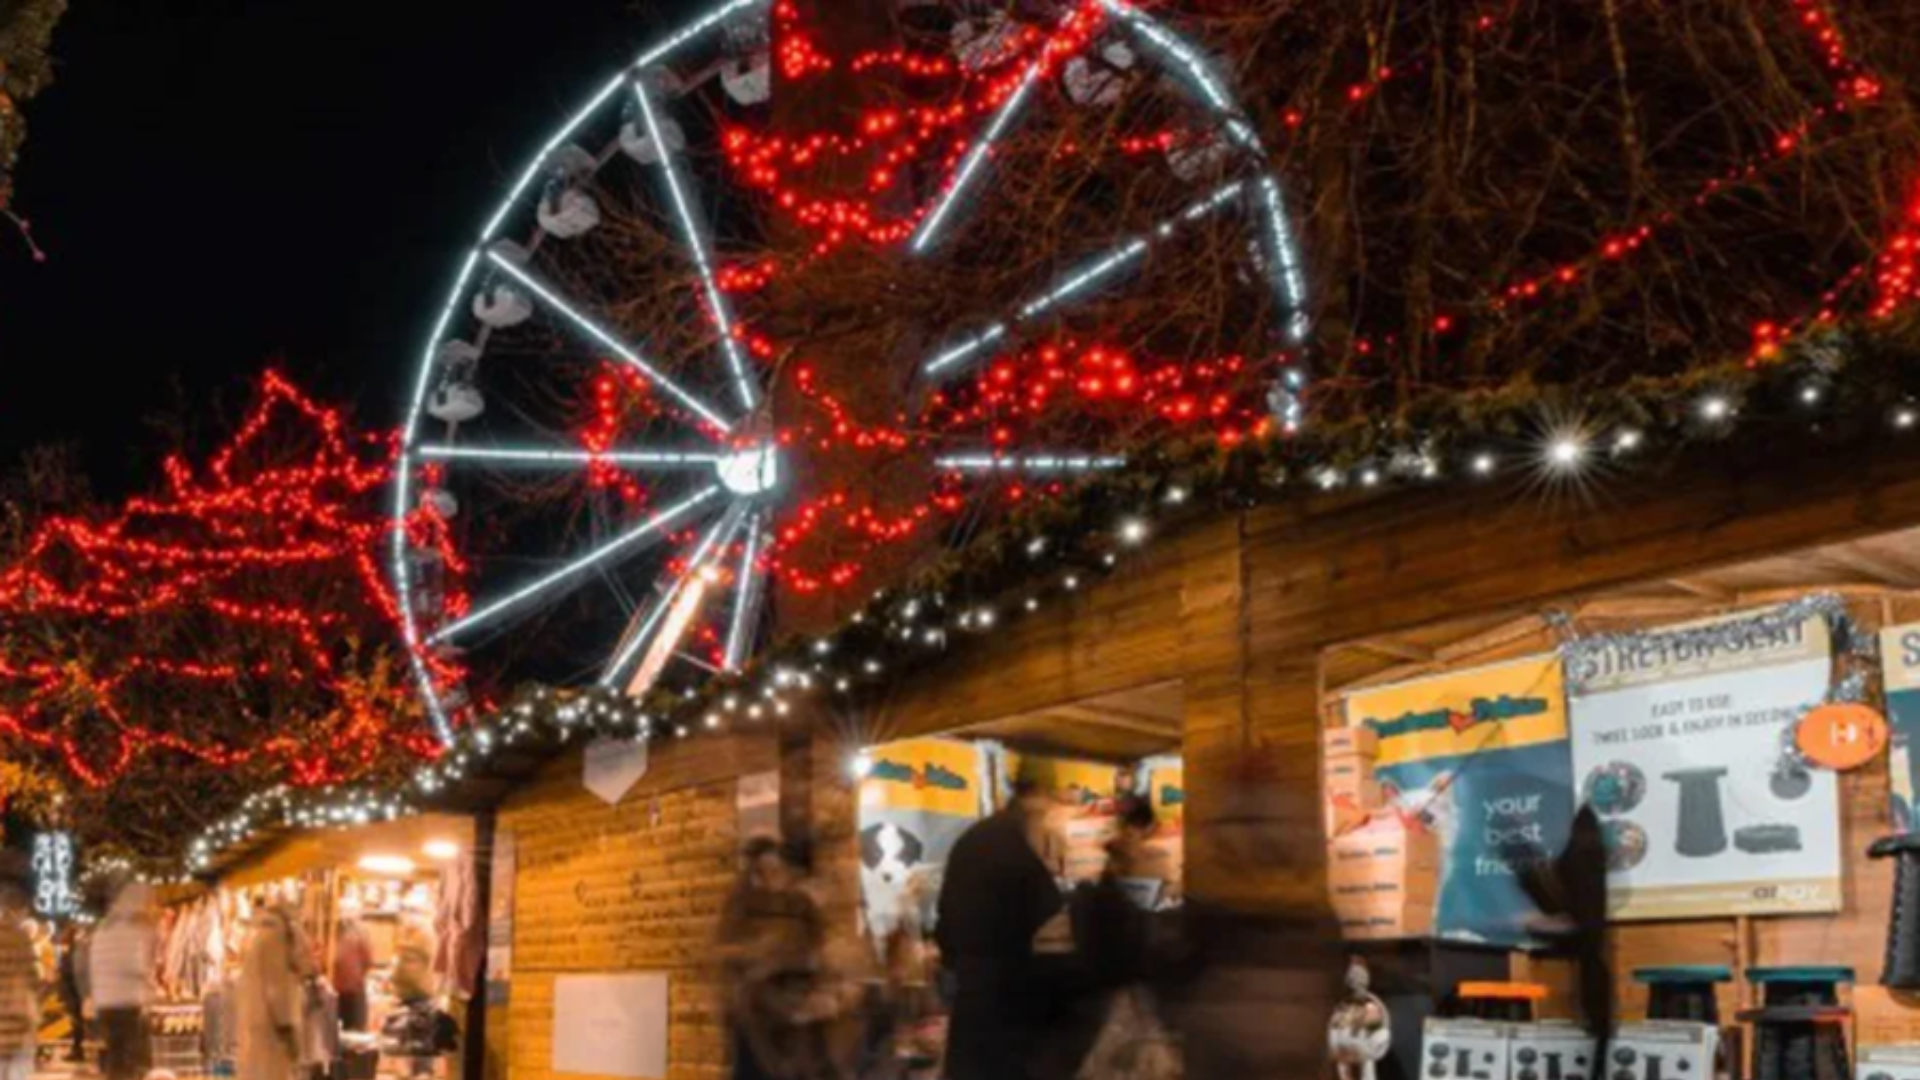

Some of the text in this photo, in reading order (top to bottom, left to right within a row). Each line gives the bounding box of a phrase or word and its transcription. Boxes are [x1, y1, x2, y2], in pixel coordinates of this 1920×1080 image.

[1651, 699, 1684, 718] EASY
[1687, 697, 1703, 713] TO
[1631, 723, 1663, 740] LOCK
[1668, 721, 1680, 736] &
[1682, 715, 1723, 733] ENJOY
[1727, 713, 1741, 728] IN
[1482, 794, 1541, 821] your
[1485, 822, 1542, 846] best
